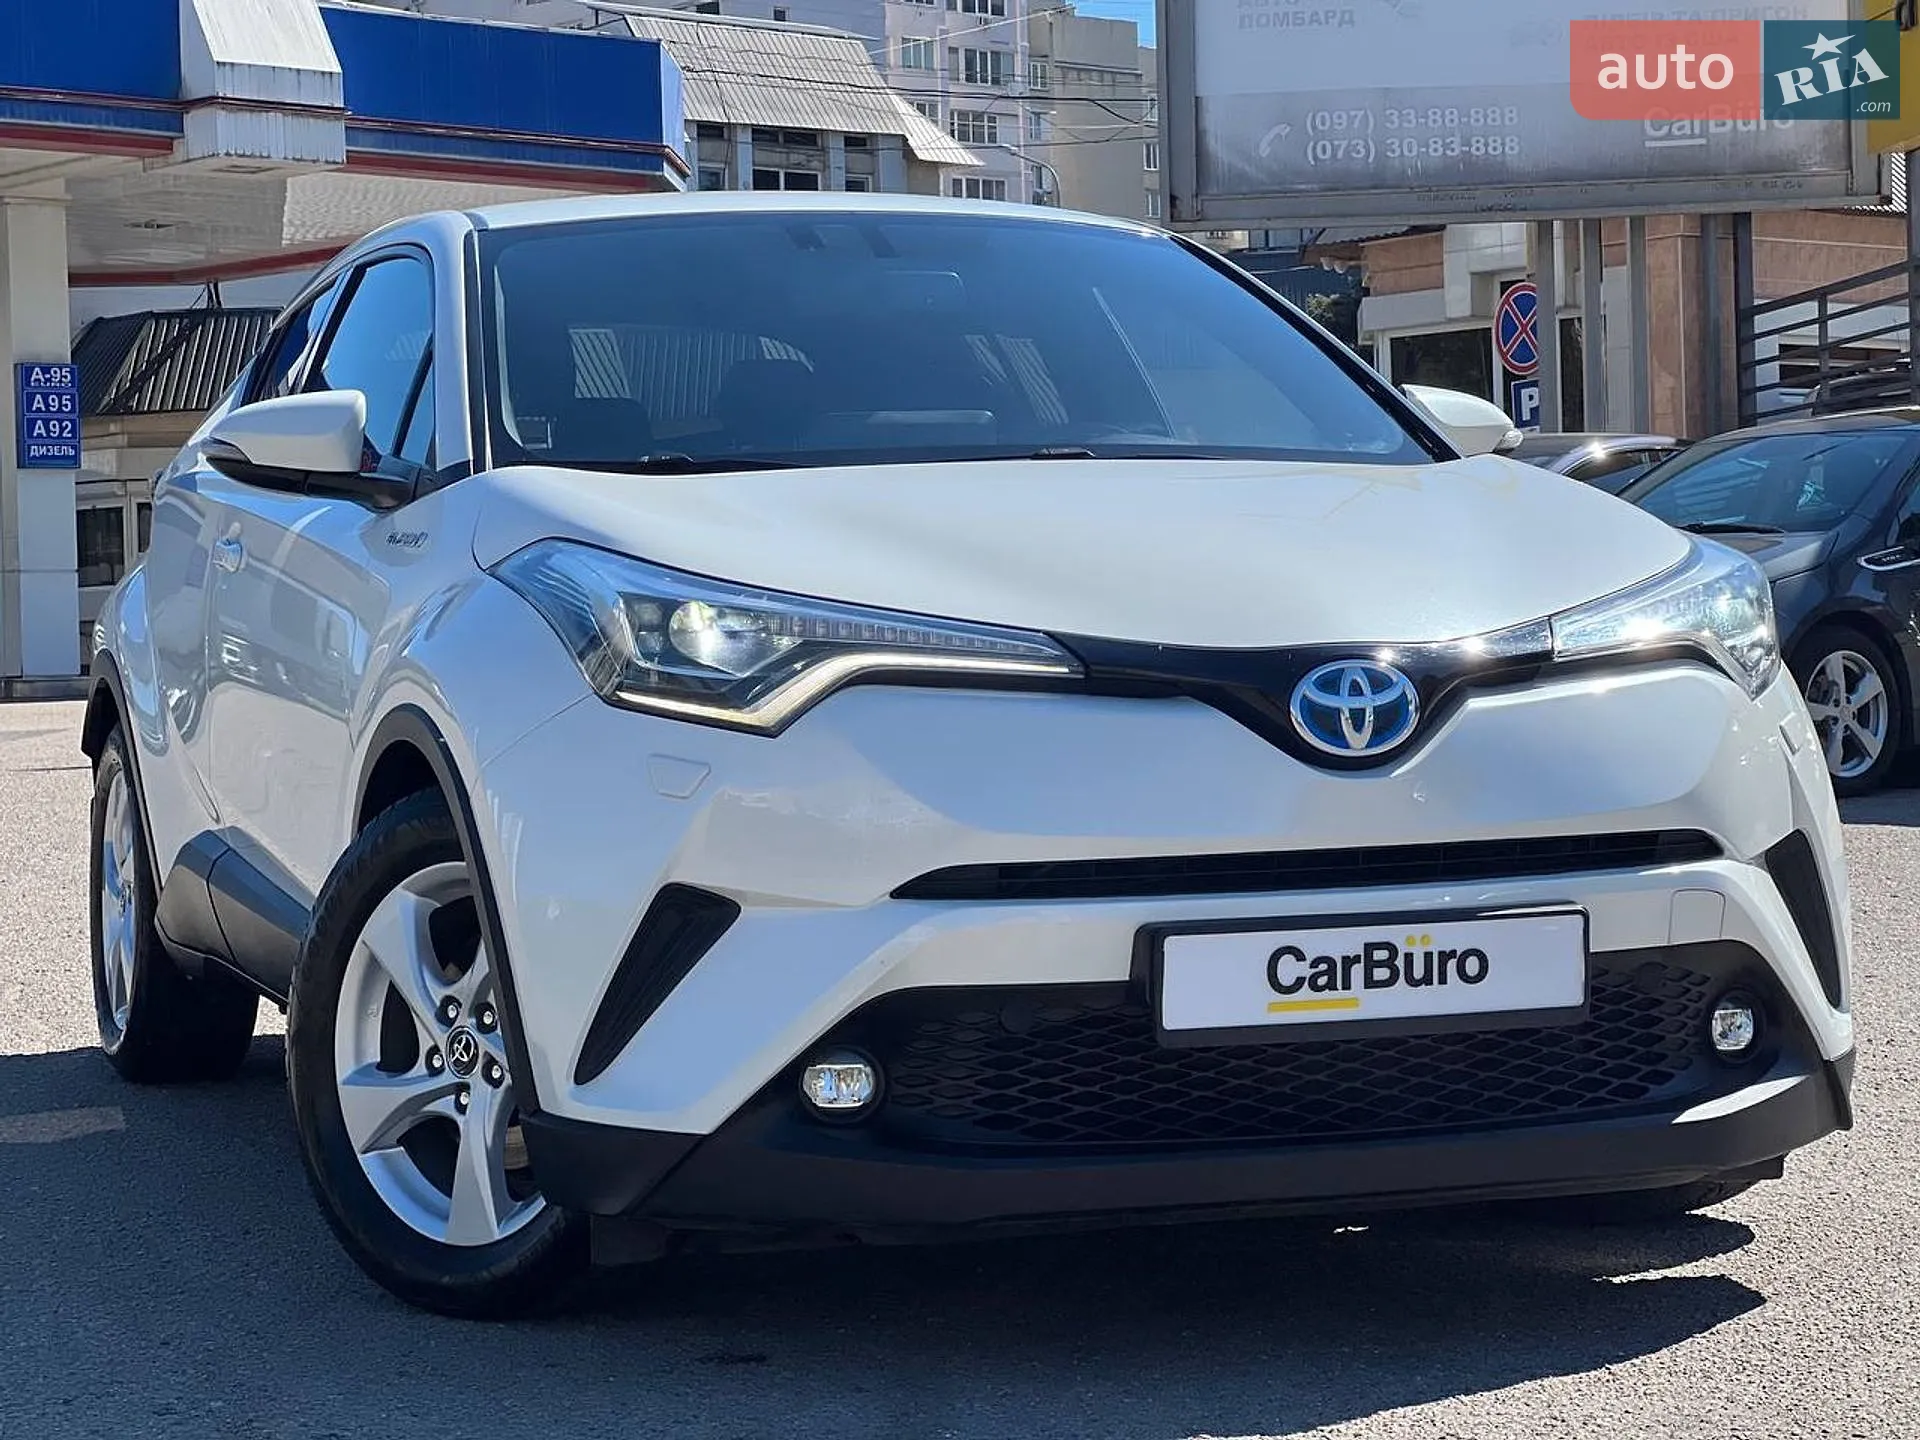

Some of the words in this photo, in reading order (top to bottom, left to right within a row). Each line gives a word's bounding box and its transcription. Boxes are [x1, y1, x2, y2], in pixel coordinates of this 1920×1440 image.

[1306, 109, 1374, 135] (097)
[1385, 107, 1518, 129] 33-88-888
[1307, 136, 1375, 165] (073)
[1386, 136, 1519, 157] 30-83-888
[30, 446, 75, 457] ДИЗЕЛЬ
[1267, 934, 1489, 995] CarBüro
